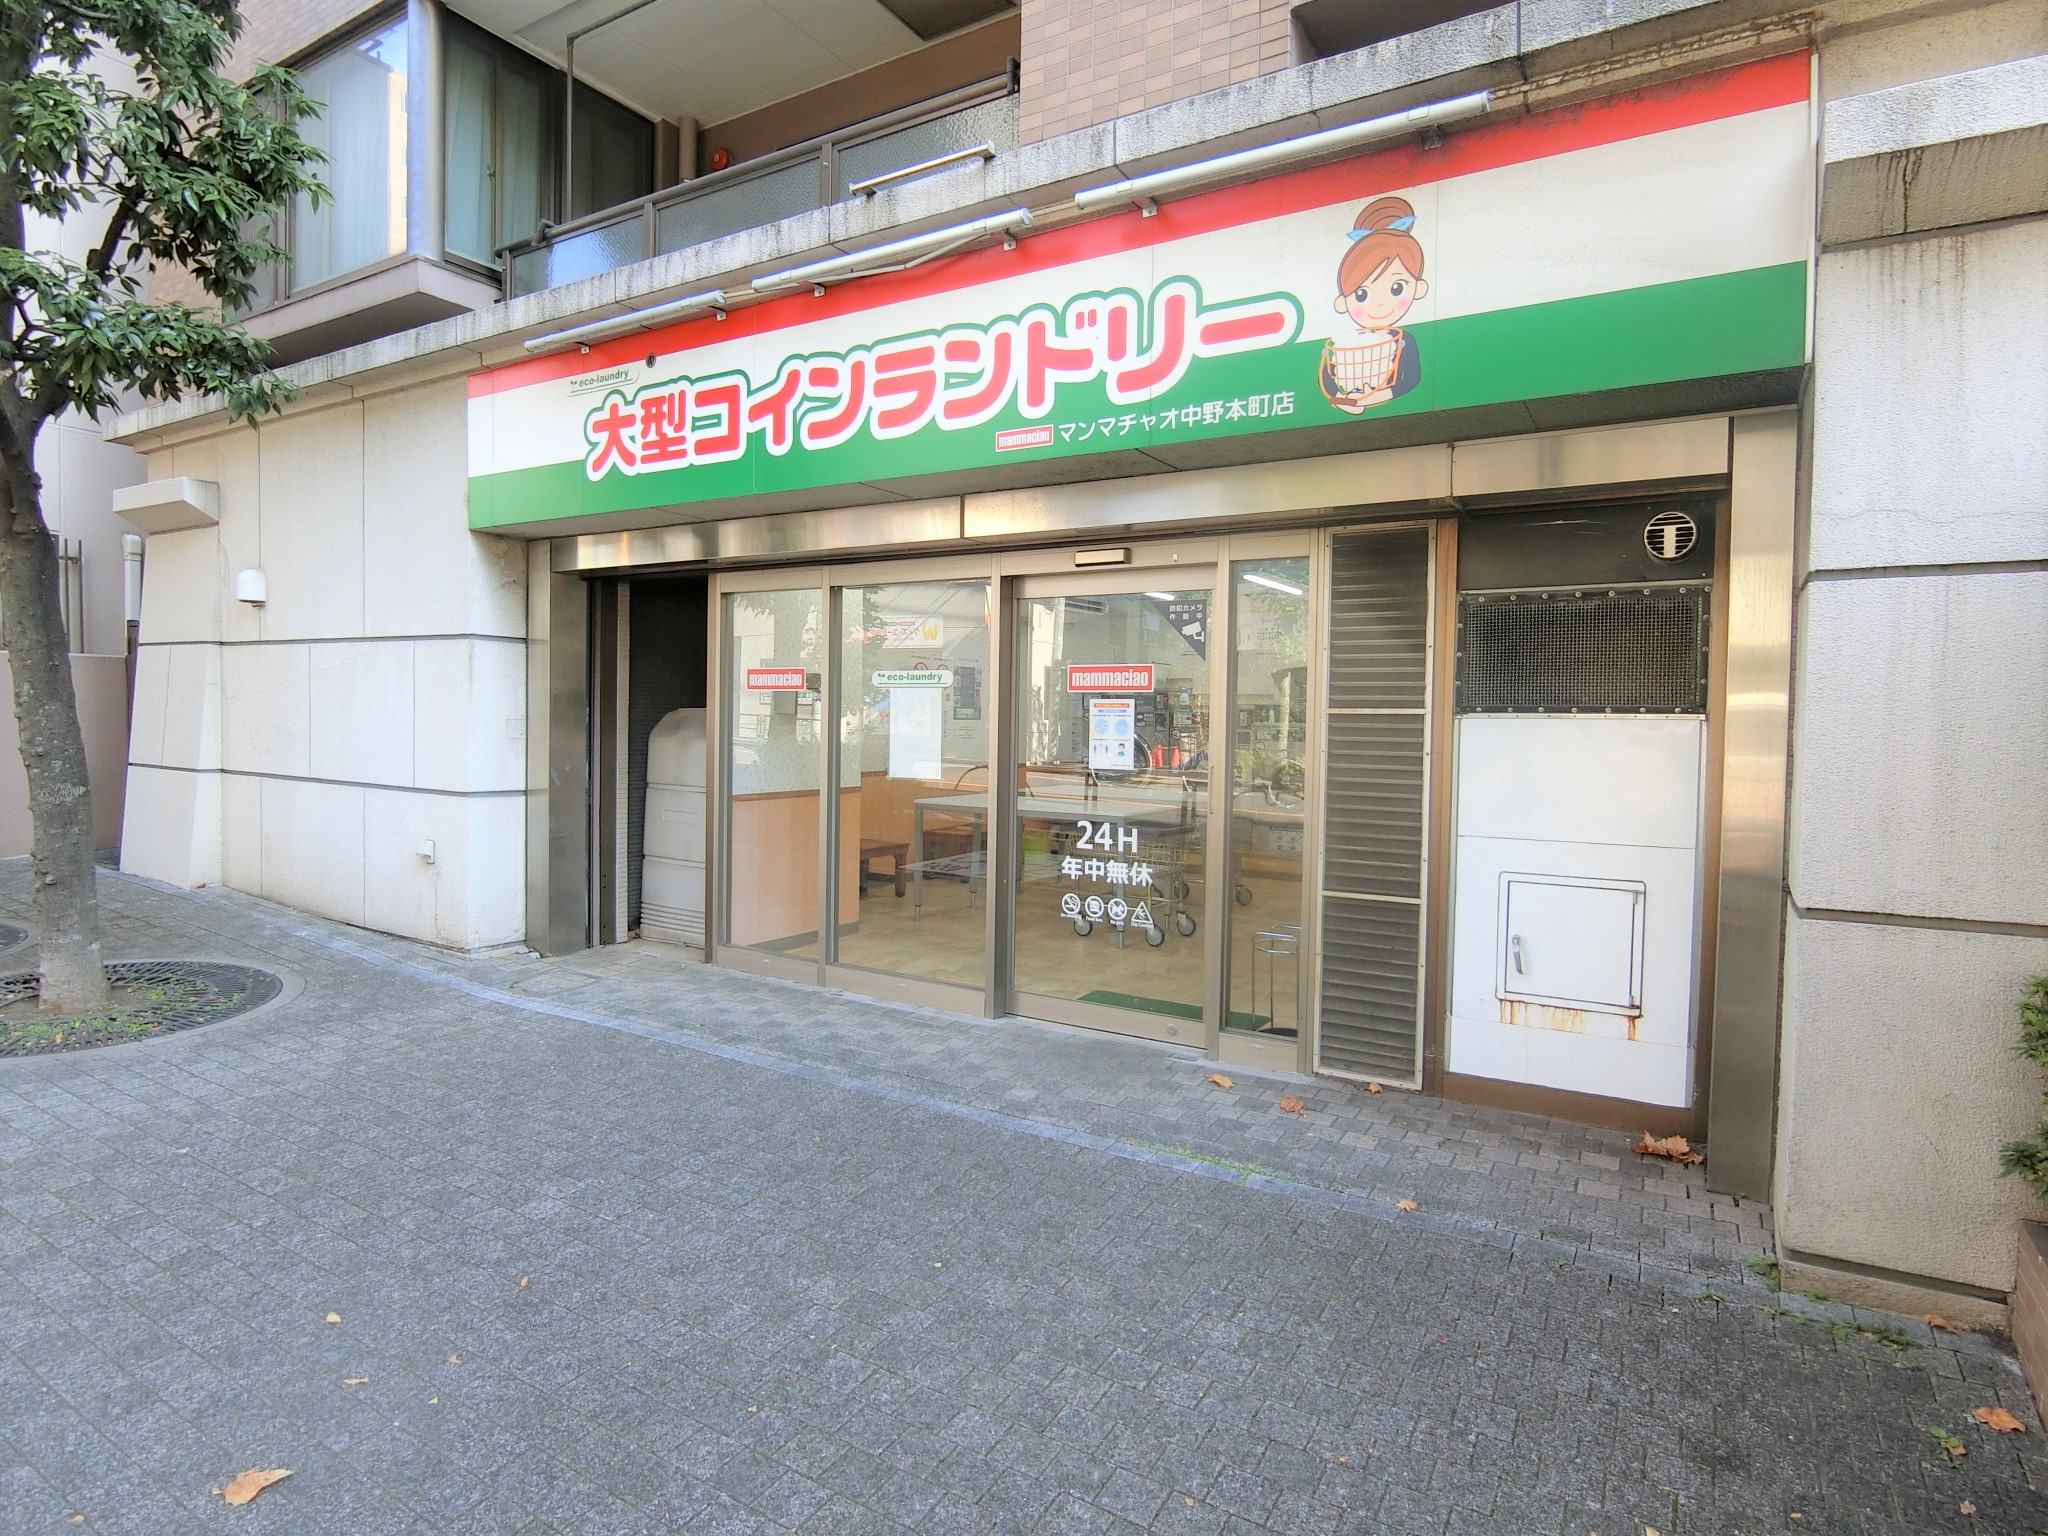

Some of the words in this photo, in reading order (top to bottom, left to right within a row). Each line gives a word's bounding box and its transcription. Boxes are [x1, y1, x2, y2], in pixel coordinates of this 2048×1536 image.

[578, 369, 629, 387] eco-laundry
[588, 290, 1290, 477] 大型コインランドリー
[1059, 391, 1295, 443] マンマチャオ中野本町店
[998, 429, 1050, 448] mammaciao
[1169, 604, 1203, 612] 防犯カメラ
[749, 671, 802, 686] mammaciao
[887, 672, 943, 682] eco-laundry
[1072, 669, 1149, 687] mammaciao
[1076, 820, 1138, 853] 24H
[1061, 855, 1153, 887] 年中無休
